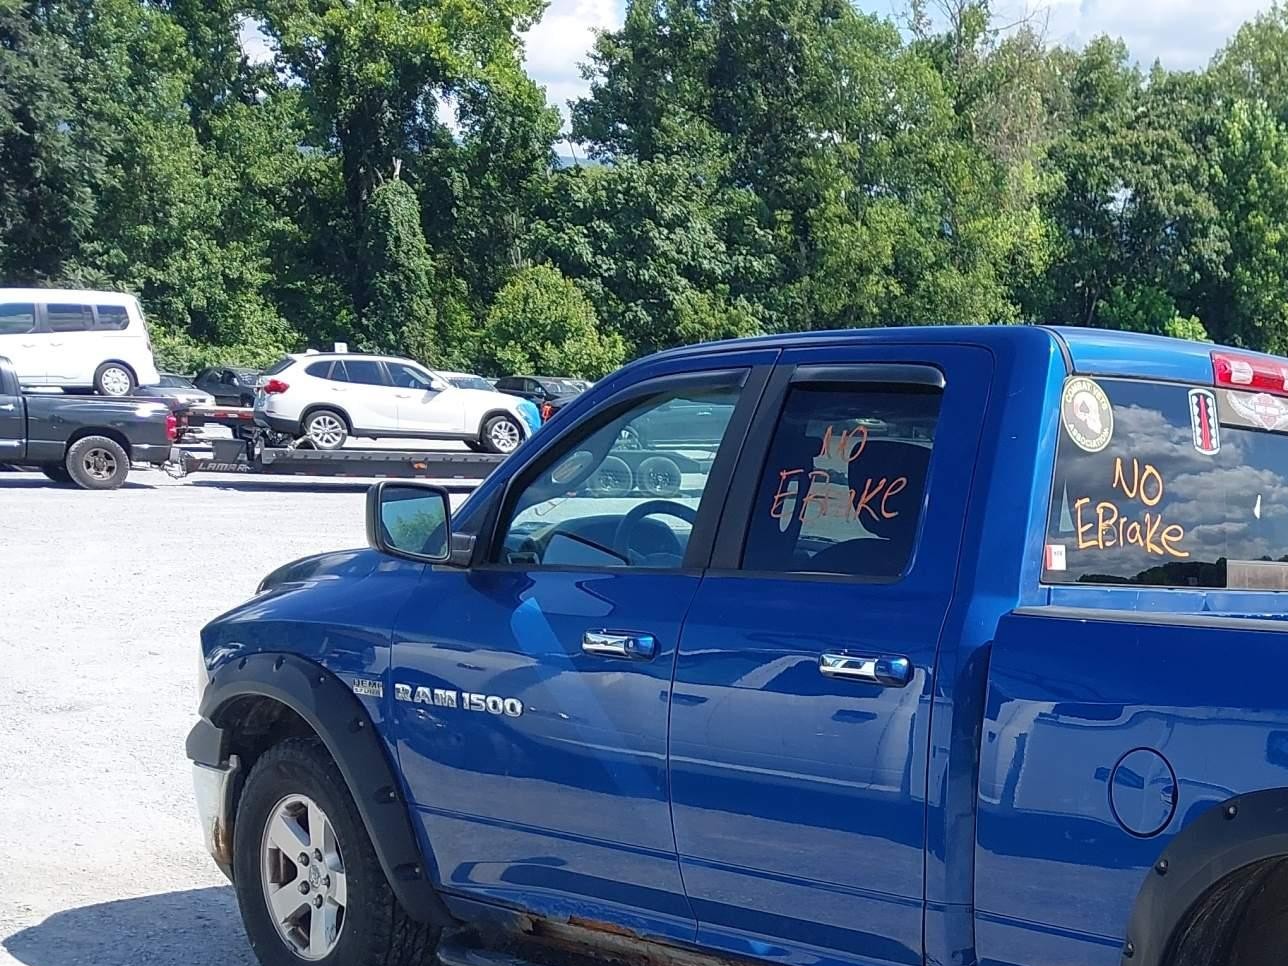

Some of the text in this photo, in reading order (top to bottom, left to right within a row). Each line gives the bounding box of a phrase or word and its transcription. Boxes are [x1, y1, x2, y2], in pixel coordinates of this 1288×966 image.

[820, 425, 868, 463] NO
[1068, 423, 1110, 448] ASSOCIATION
[1112, 456, 1164, 507] NO
[394, 683, 524, 717] RAM 1500
